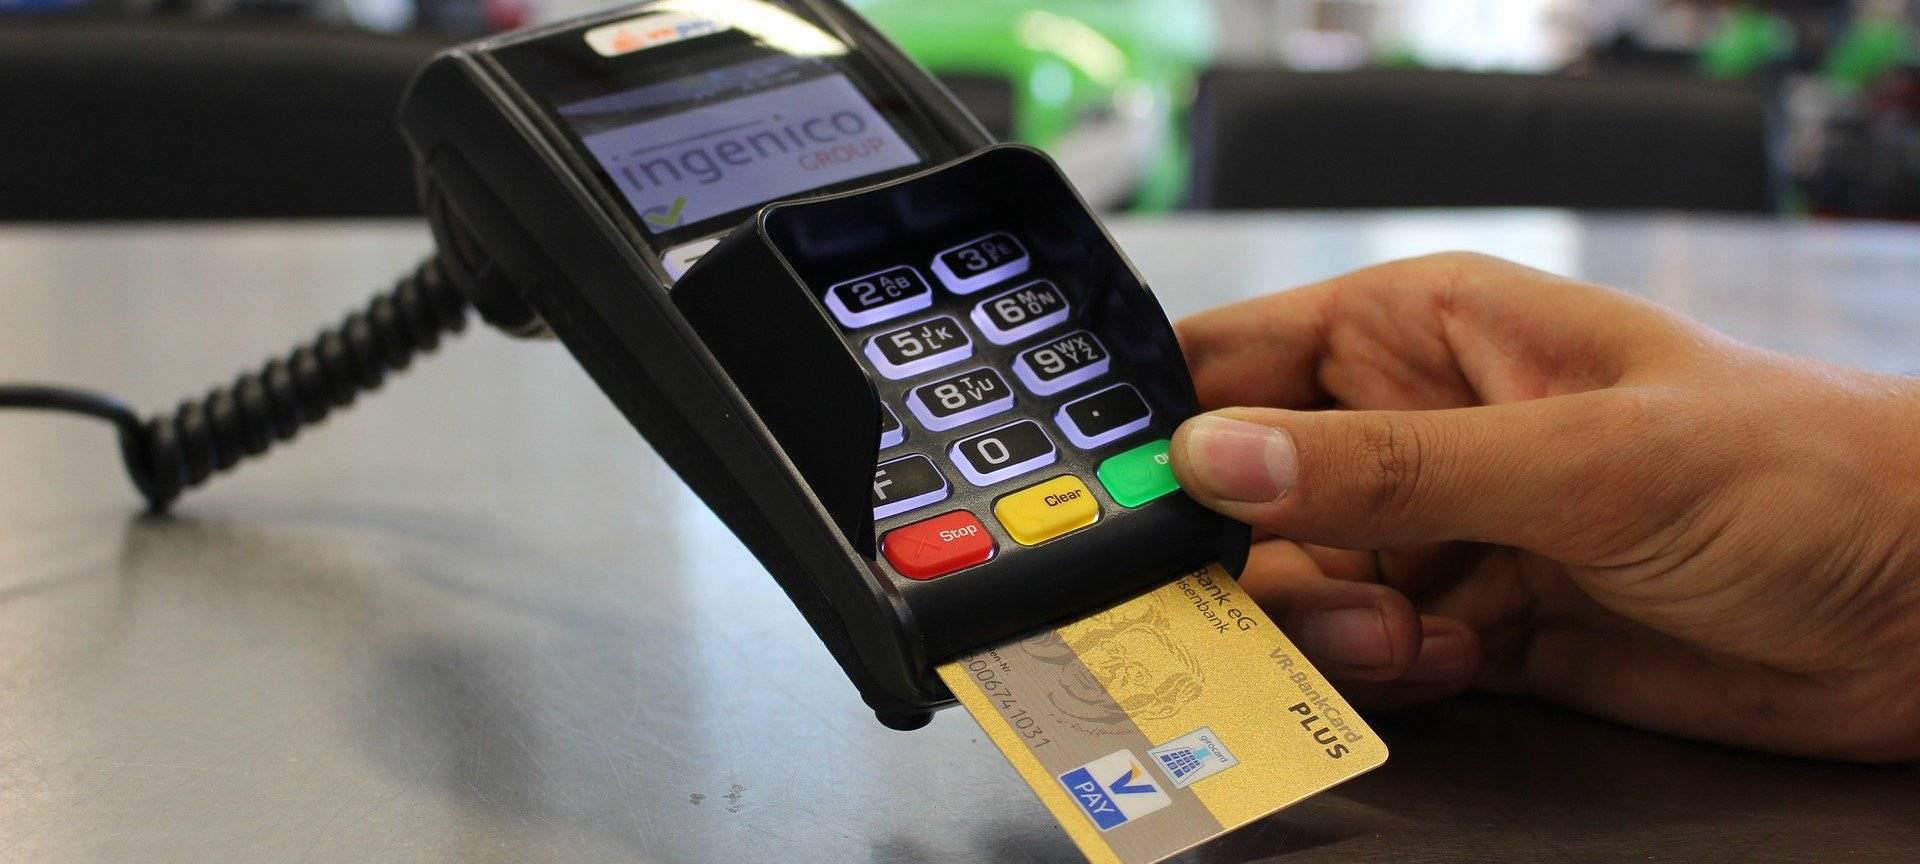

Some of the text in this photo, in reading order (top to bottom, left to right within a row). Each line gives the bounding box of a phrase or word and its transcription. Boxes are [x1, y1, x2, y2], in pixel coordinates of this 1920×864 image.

[612, 110, 867, 192] ingenico
[798, 136, 886, 173] GROUP
[957, 248, 989, 271] 3
[852, 281, 885, 306] 2
[995, 298, 1026, 323] 6
[891, 330, 924, 357] 5
[1033, 349, 1066, 374] 9
[934, 383, 967, 410] 8
[1044, 488, 1082, 508] Clear
[939, 523, 977, 543] Stop
[1176, 579, 1229, 634] isenbank
[1228, 608, 1257, 631] eG
[1269, 646, 1363, 743] VR-BankCard
[1288, 701, 1349, 759] PLUS
[1200, 734, 1228, 764] girocard
[1074, 781, 1115, 815] PAY
